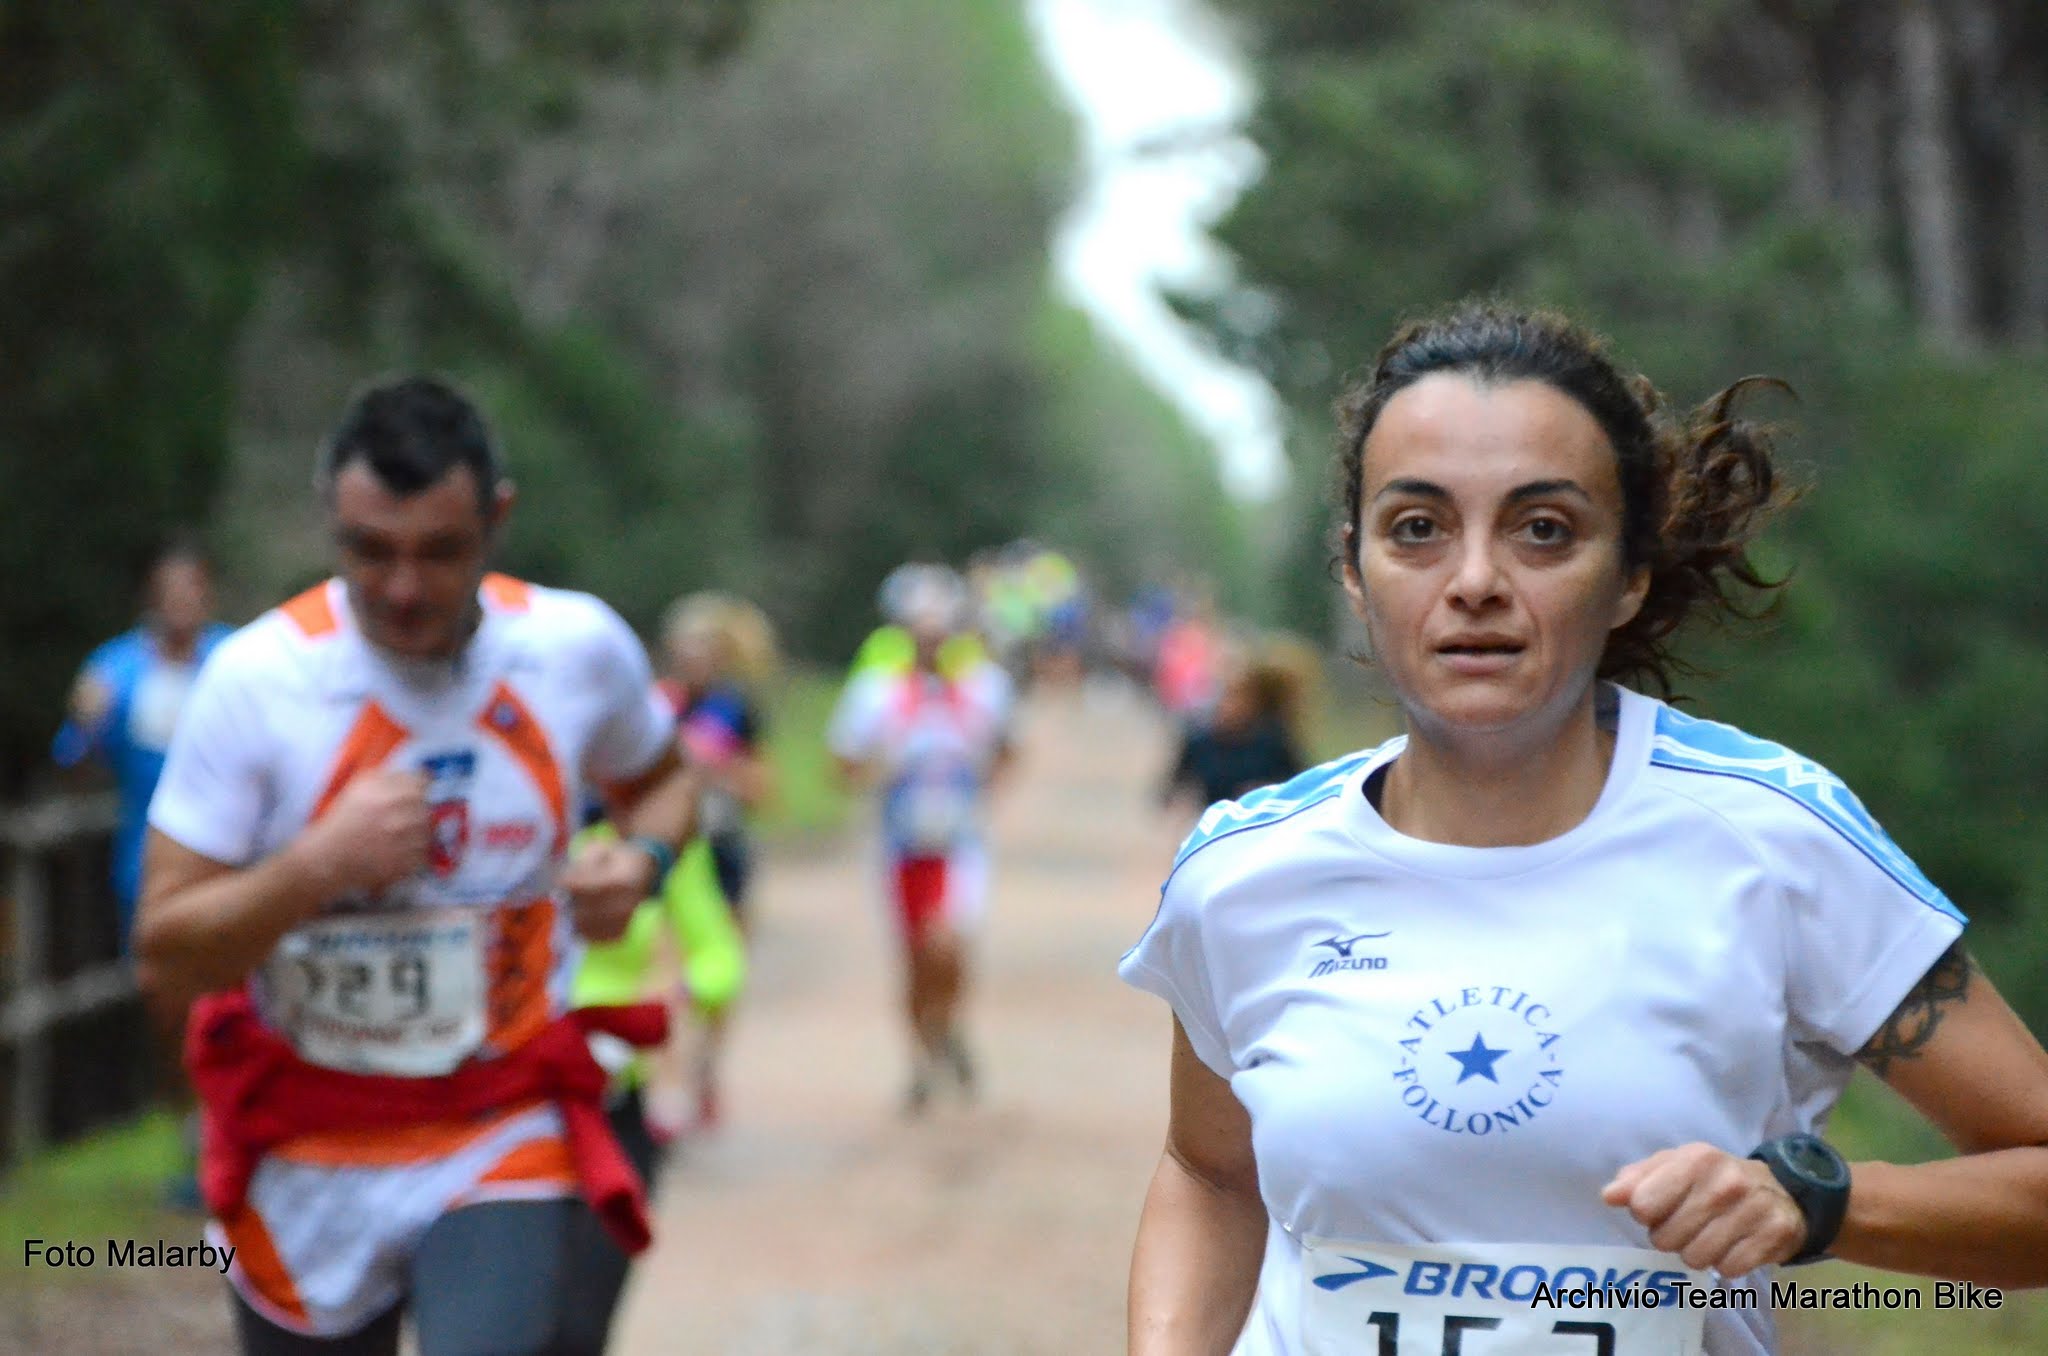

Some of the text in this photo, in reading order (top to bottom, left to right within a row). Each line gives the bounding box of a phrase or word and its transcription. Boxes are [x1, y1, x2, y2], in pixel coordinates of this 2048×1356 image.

[1399, 986, 1562, 1055] ATLETICA
[1393, 1066, 1563, 1136] FOLLONICA
[1403, 1261, 1687, 1306] BROOKS
